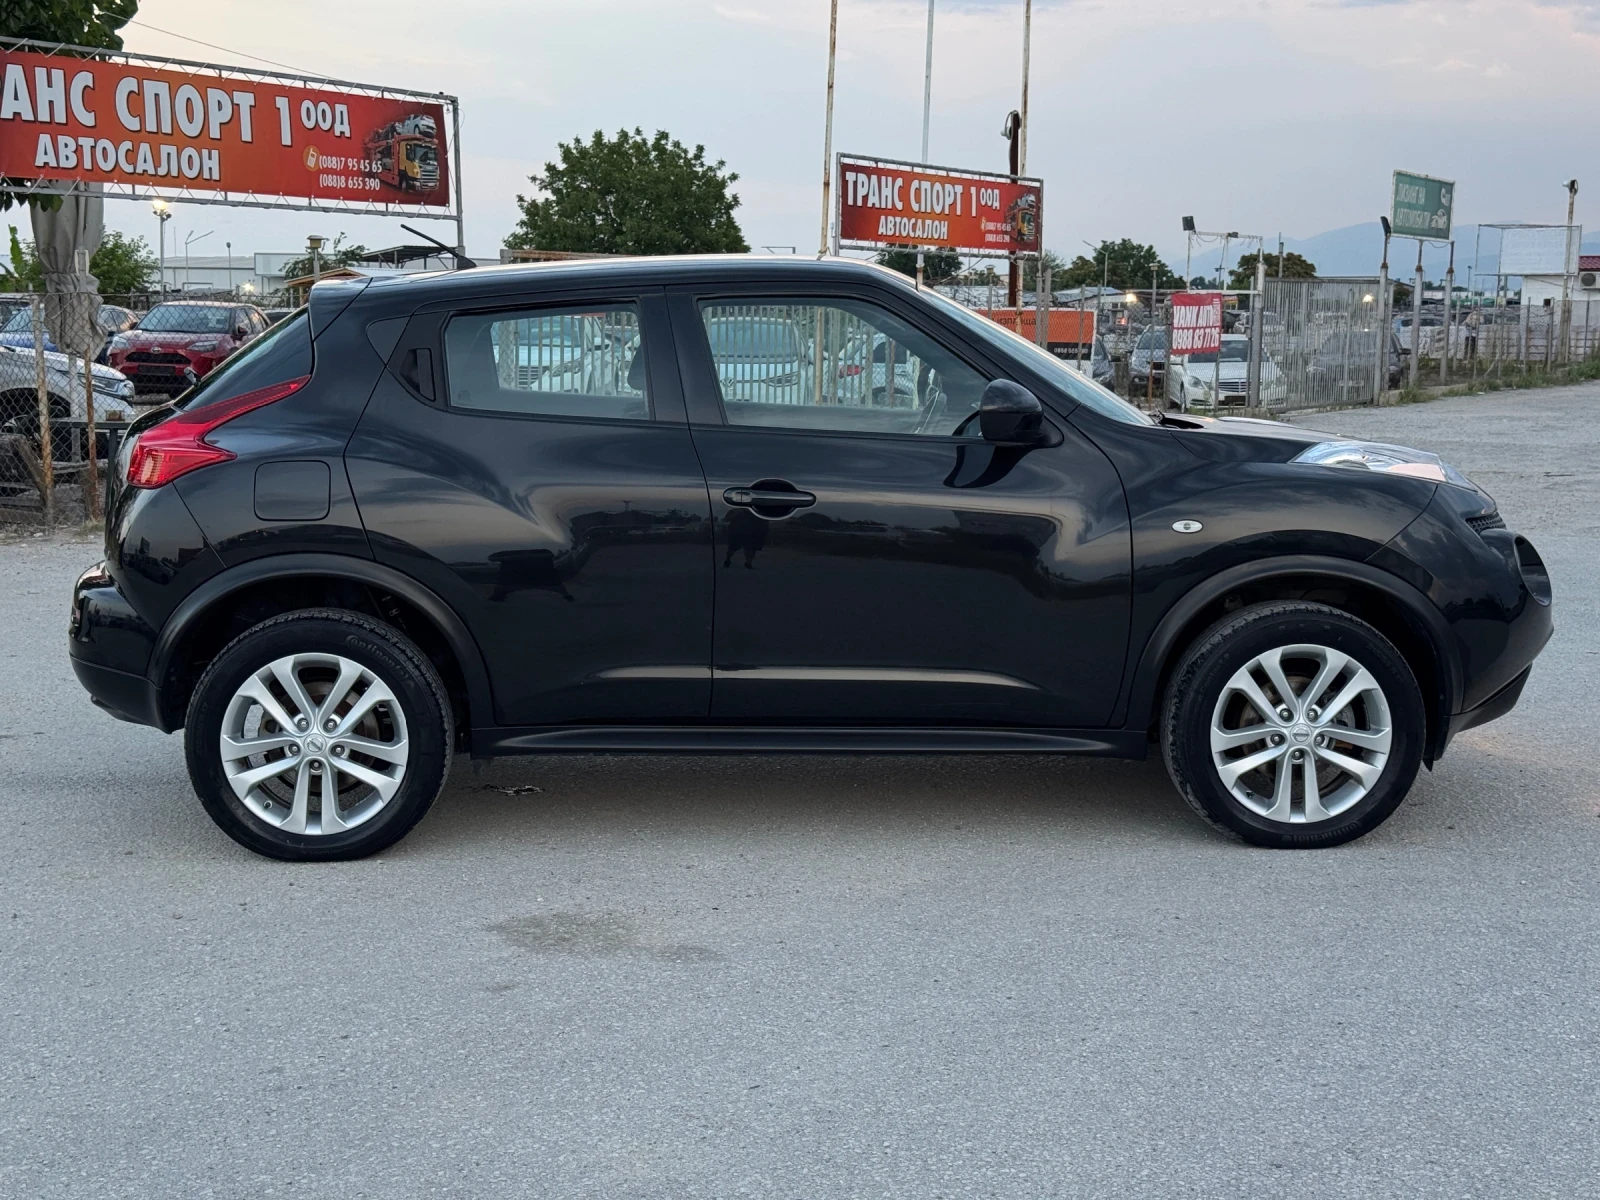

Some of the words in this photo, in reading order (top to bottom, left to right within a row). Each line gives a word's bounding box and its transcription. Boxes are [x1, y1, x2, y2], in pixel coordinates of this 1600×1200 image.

[115, 76, 256, 143] СПОРТ
[275, 96, 292, 146] 1
[301, 100, 351, 138] ООД
[34, 134, 220, 181] АВТОСАЛОН
[319, 155, 345, 171] (088)7
[347, 158, 358, 171] 95
[360, 159, 370, 172] 45
[371, 160, 383, 173] 65
[319, 174, 345, 189] (088)8
[348, 176, 363, 189] 655
[364, 178, 380, 191] 390
[845, 171, 903, 211] ТРАНС
[910, 179, 963, 216] СПОРТ
[970, 186, 977, 217] 1
[980, 189, 1000, 210] ООД
[878, 215, 948, 240] АВТОСАЛОН
[1395, 207, 1431, 229] АВТОМОБИЛИ
